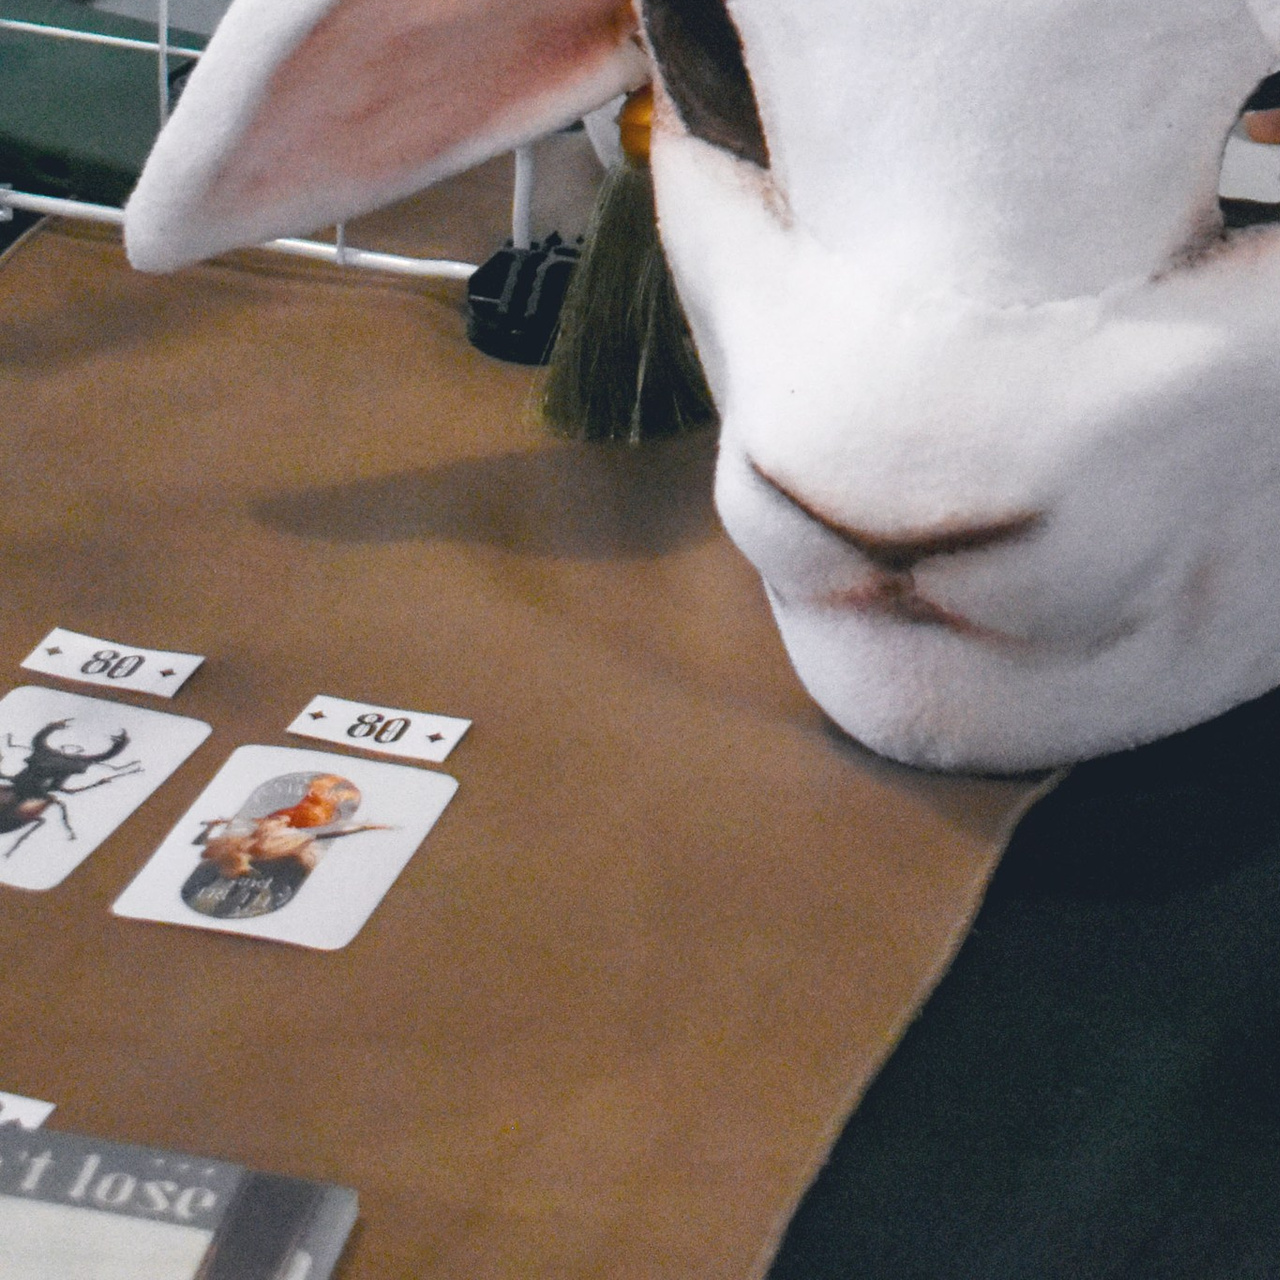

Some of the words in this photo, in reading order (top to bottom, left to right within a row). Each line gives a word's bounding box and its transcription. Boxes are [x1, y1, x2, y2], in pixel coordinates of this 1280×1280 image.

[80, 649, 146, 679] 80
[346, 713, 412, 744] 80
[67, 1153, 218, 1220] lose
